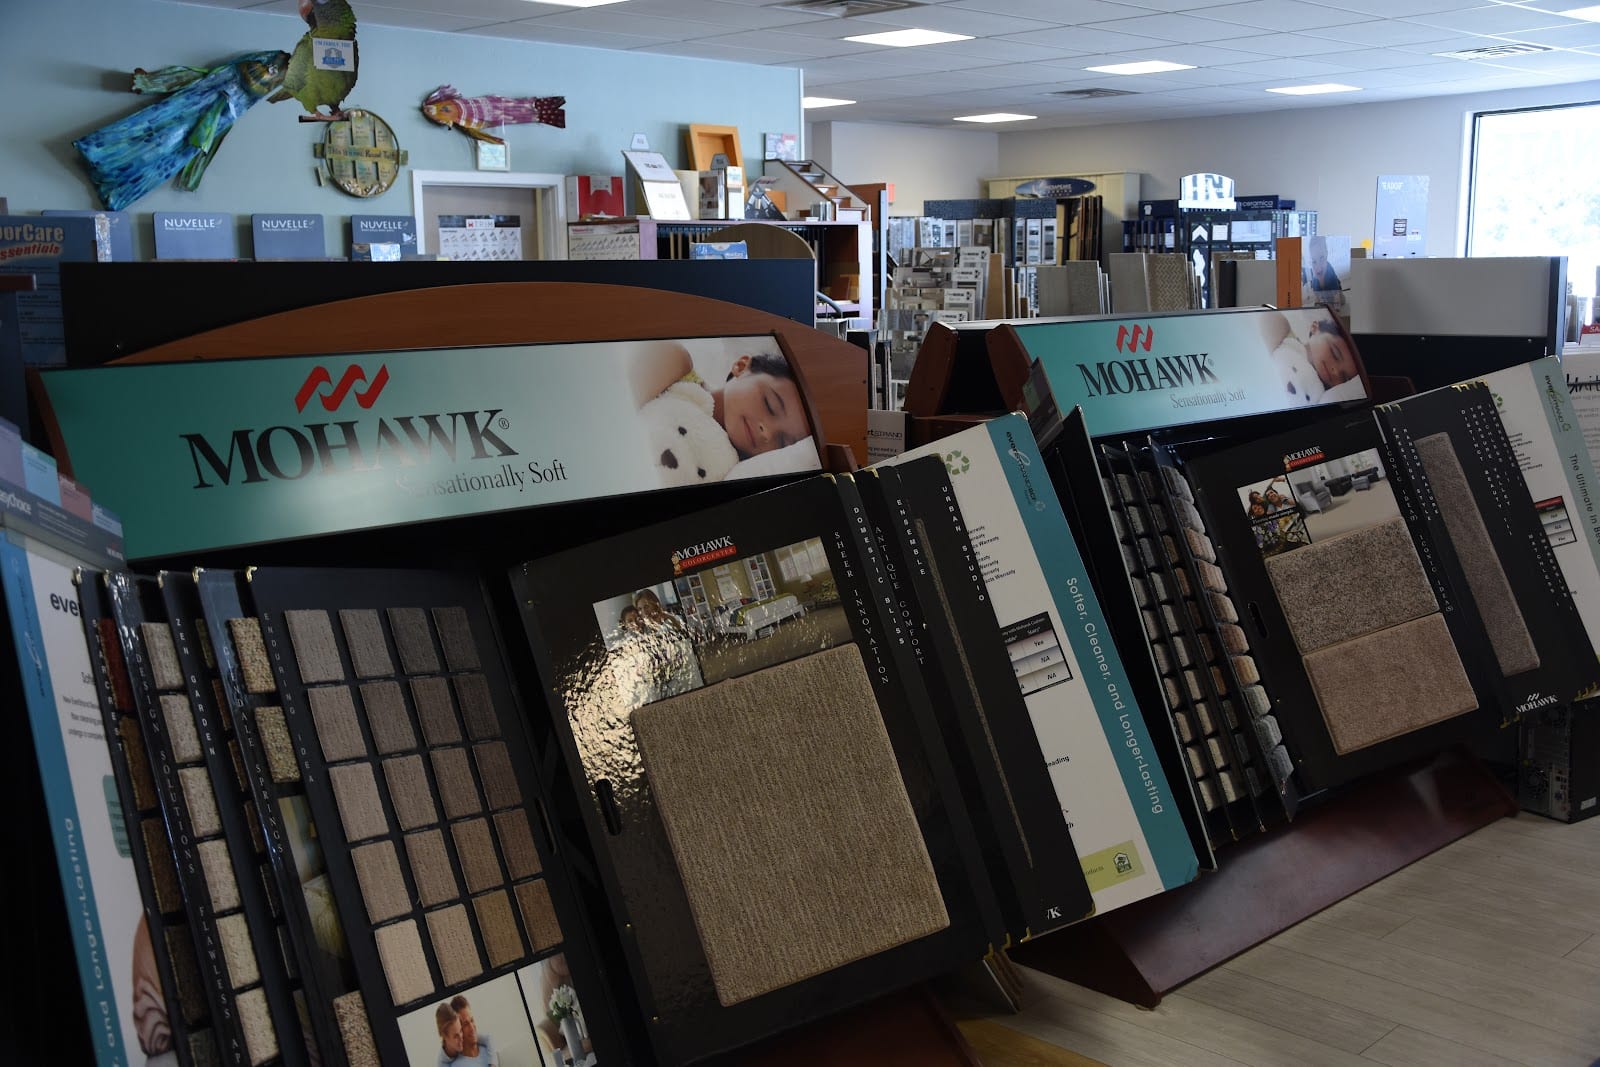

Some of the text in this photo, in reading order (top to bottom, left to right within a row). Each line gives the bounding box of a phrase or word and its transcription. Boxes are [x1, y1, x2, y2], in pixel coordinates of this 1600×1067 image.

[0, 243, 61, 261] ssentials
[164, 219, 216, 227] NUVELLE
[262, 220, 309, 228] NUVELLE
[360, 221, 402, 229] NUVELLE
[1076, 353, 1219, 397] MOHAWK
[1170, 389, 1246, 408] Sensationally Soft
[180, 409, 518, 488] MOHAWK
[1287, 446, 1322, 461] MOHAWK
[1385, 444, 1401, 482] ICONIC
[1461, 409, 1502, 508] DISTINCT BEAUTY
[1470, 407, 1492, 459] TREASURE
[1477, 404, 1503, 463] MATCHLESS
[1488, 404, 1515, 467] IMPRESSIVE
[530, 460, 568, 485] Soft
[1403, 428, 1439, 514] RANDOM NATURE
[1569, 454, 1579, 471] The
[1577, 473, 1593, 512] Ultimate
[1416, 488, 1432, 521] STYLE
[676, 536, 735, 560] MOHAWK
[896, 499, 926, 575] ENSEMBLE
[942, 486, 985, 602] URBAN STUDIO
[1420, 535, 1437, 573] ICONIC
[1528, 534, 1555, 593] MATCHLESS
[1539, 532, 1568, 598] IMPRESSIVE
[834, 531, 889, 684] SHEER INNOVATION
[853, 507, 905, 645] DOMESTIC BLISS
[875, 526, 924, 665] ANTIQUE COMFORT
[92, 620, 124, 751] STARCREST
[175, 618, 216, 756] ZEN GARDEN
[264, 612, 315, 783] ENDURING IDEA
[1066, 577, 1163, 814] Softer, Cleaner, and Longer-Lasting
[1516, 694, 1559, 714] MOHAWK
[135, 653, 195, 874] DESIGN SOLUTIONS
[222, 646, 284, 854] GLENDALE SPRINGS
[64, 817, 116, 1048] and Longer-Lasting
[200, 906, 230, 1019] FLAWLESS
